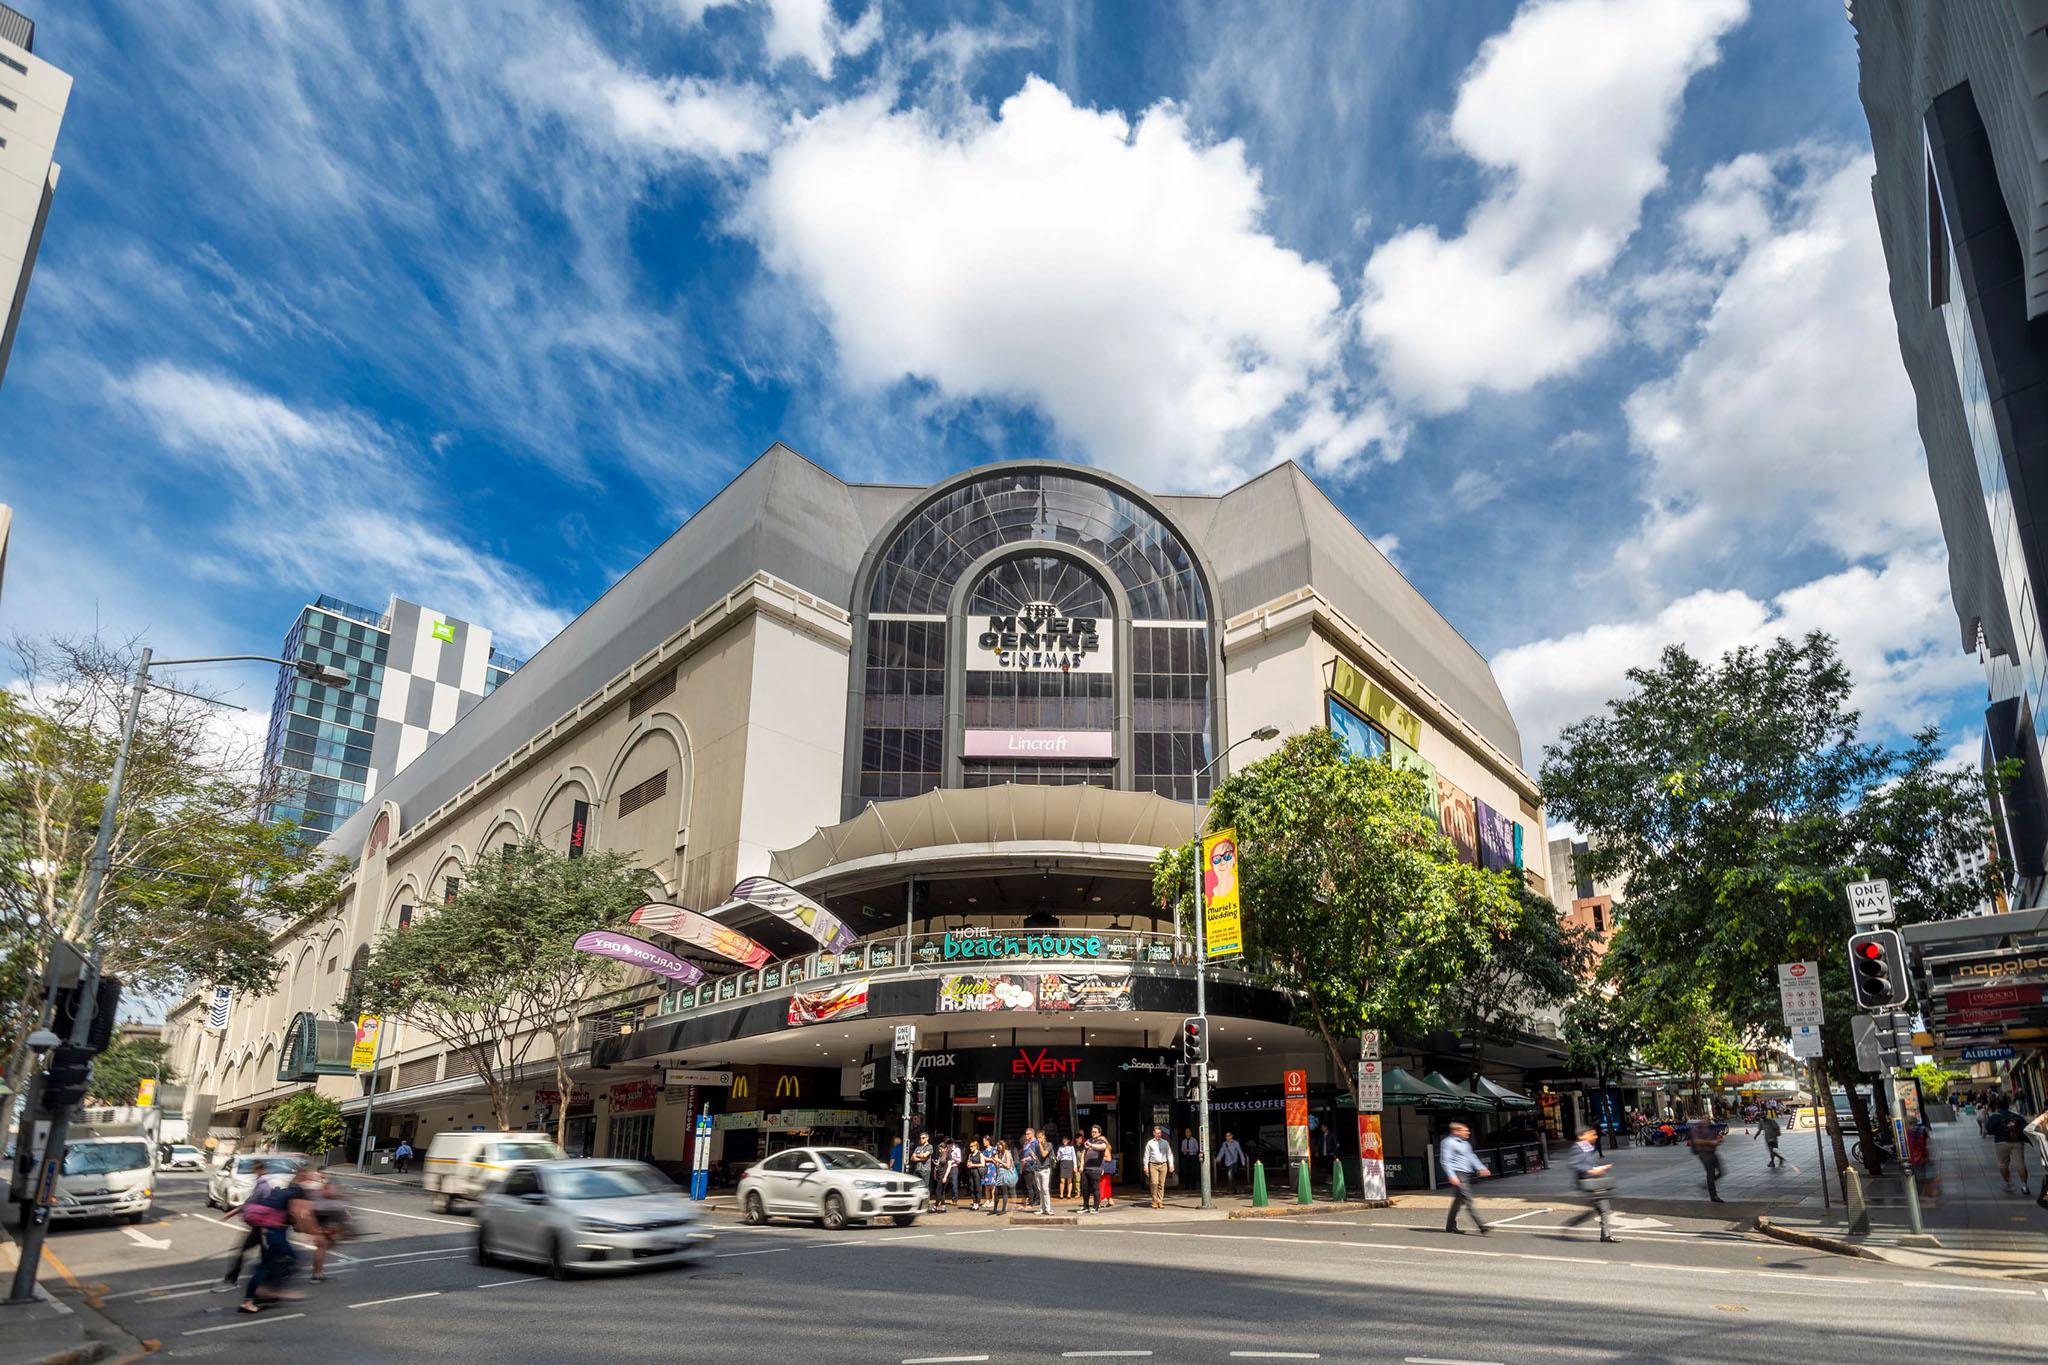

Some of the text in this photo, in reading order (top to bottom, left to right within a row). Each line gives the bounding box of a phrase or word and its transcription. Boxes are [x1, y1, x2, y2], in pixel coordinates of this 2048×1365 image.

[1024, 604, 1056, 617] THE
[989, 616, 1097, 634] MYER
[979, 632, 1099, 652] CENTRE
[999, 651, 1082, 668] CINEMAS
[1008, 734, 1069, 752] Lincraft
[1855, 884, 1882, 896] ONE
[1208, 902, 1237, 914] Muriel's
[1855, 896, 1885, 908] WAY
[1208, 910, 1238, 921] Wedding
[956, 927, 991, 938] HOTEL
[945, 932, 1100, 958] beach house
[941, 975, 989, 1001] Lunch
[1040, 983, 1069, 993] LOVE
[940, 993, 995, 1011] RUMP
[1973, 990, 2014, 1001] DYMOCKS
[1946, 1028, 1979, 1036] Universal
[1965, 1049, 2001, 1059] ALBERT
[1012, 1048, 1082, 1074] EVENT
[1190, 1099, 1286, 1112] STRBUCKS COFFEE
